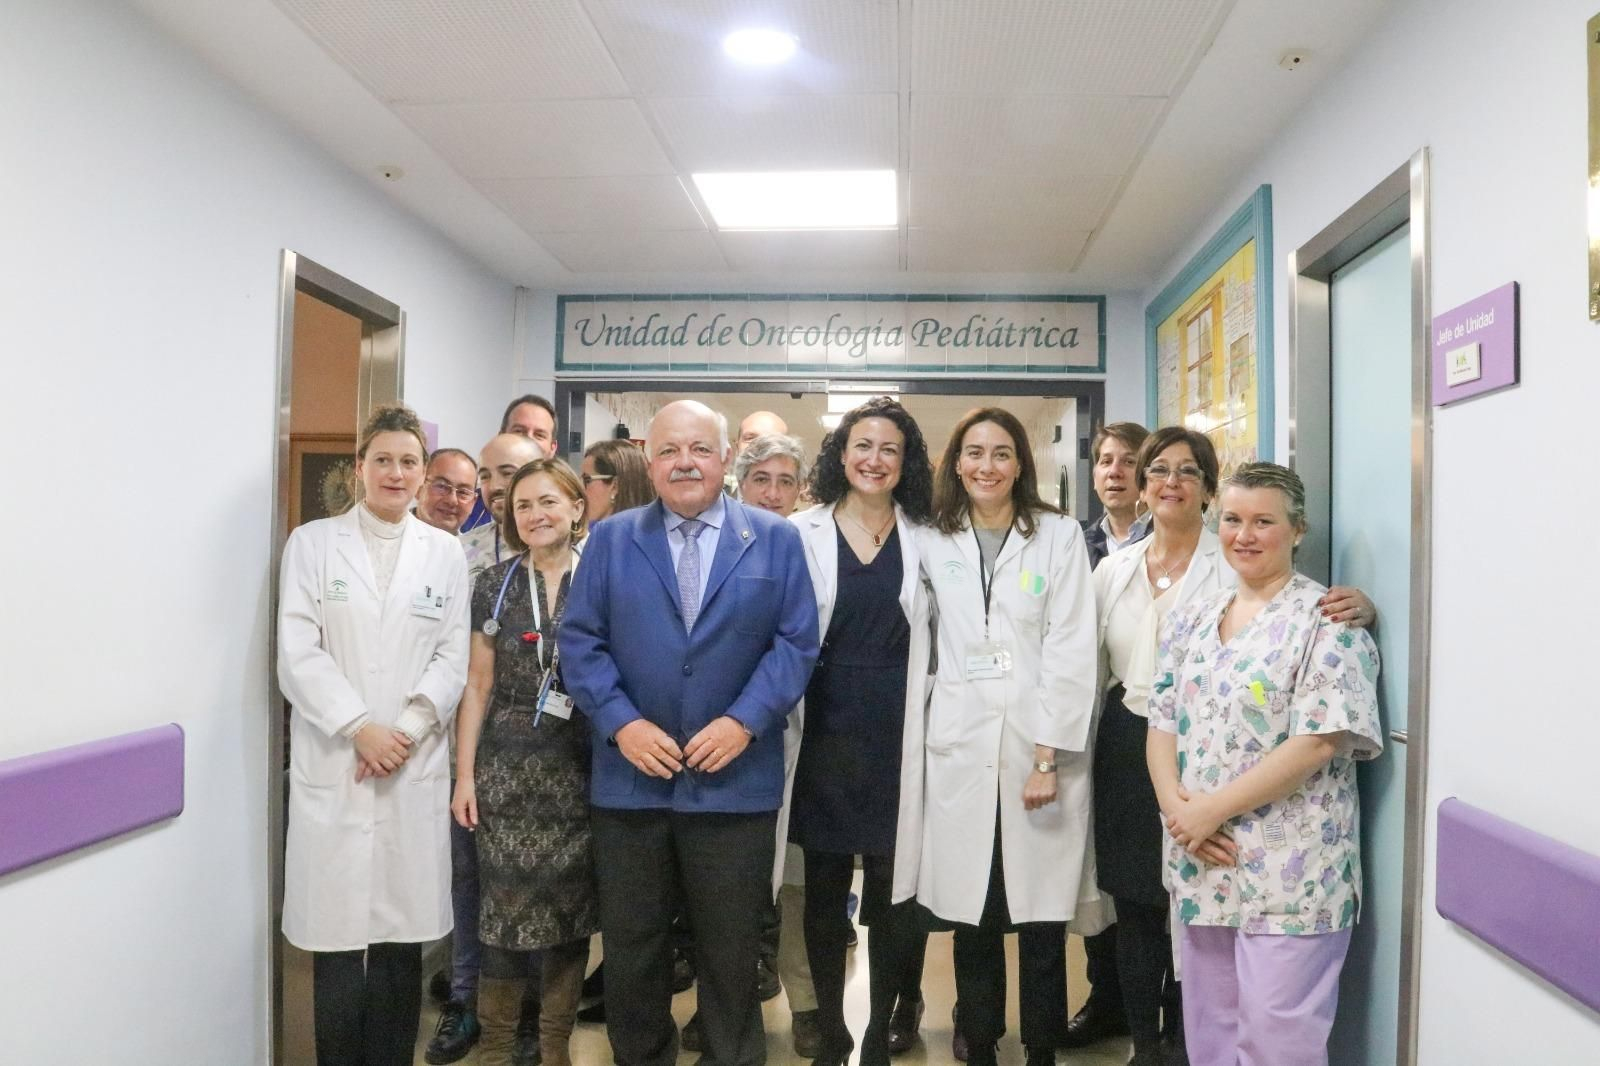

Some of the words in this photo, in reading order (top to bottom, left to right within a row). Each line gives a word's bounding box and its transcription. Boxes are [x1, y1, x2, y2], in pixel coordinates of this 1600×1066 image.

[575, 313, 697, 347] Unidad
[698, 313, 733, 347] de
[739, 313, 904, 359] Oncología
[911, 314, 1080, 349] Pediátrica
[1436, 327, 1453, 346] Jefe
[1454, 322, 1465, 339] de
[1466, 307, 1495, 334] Unidad
